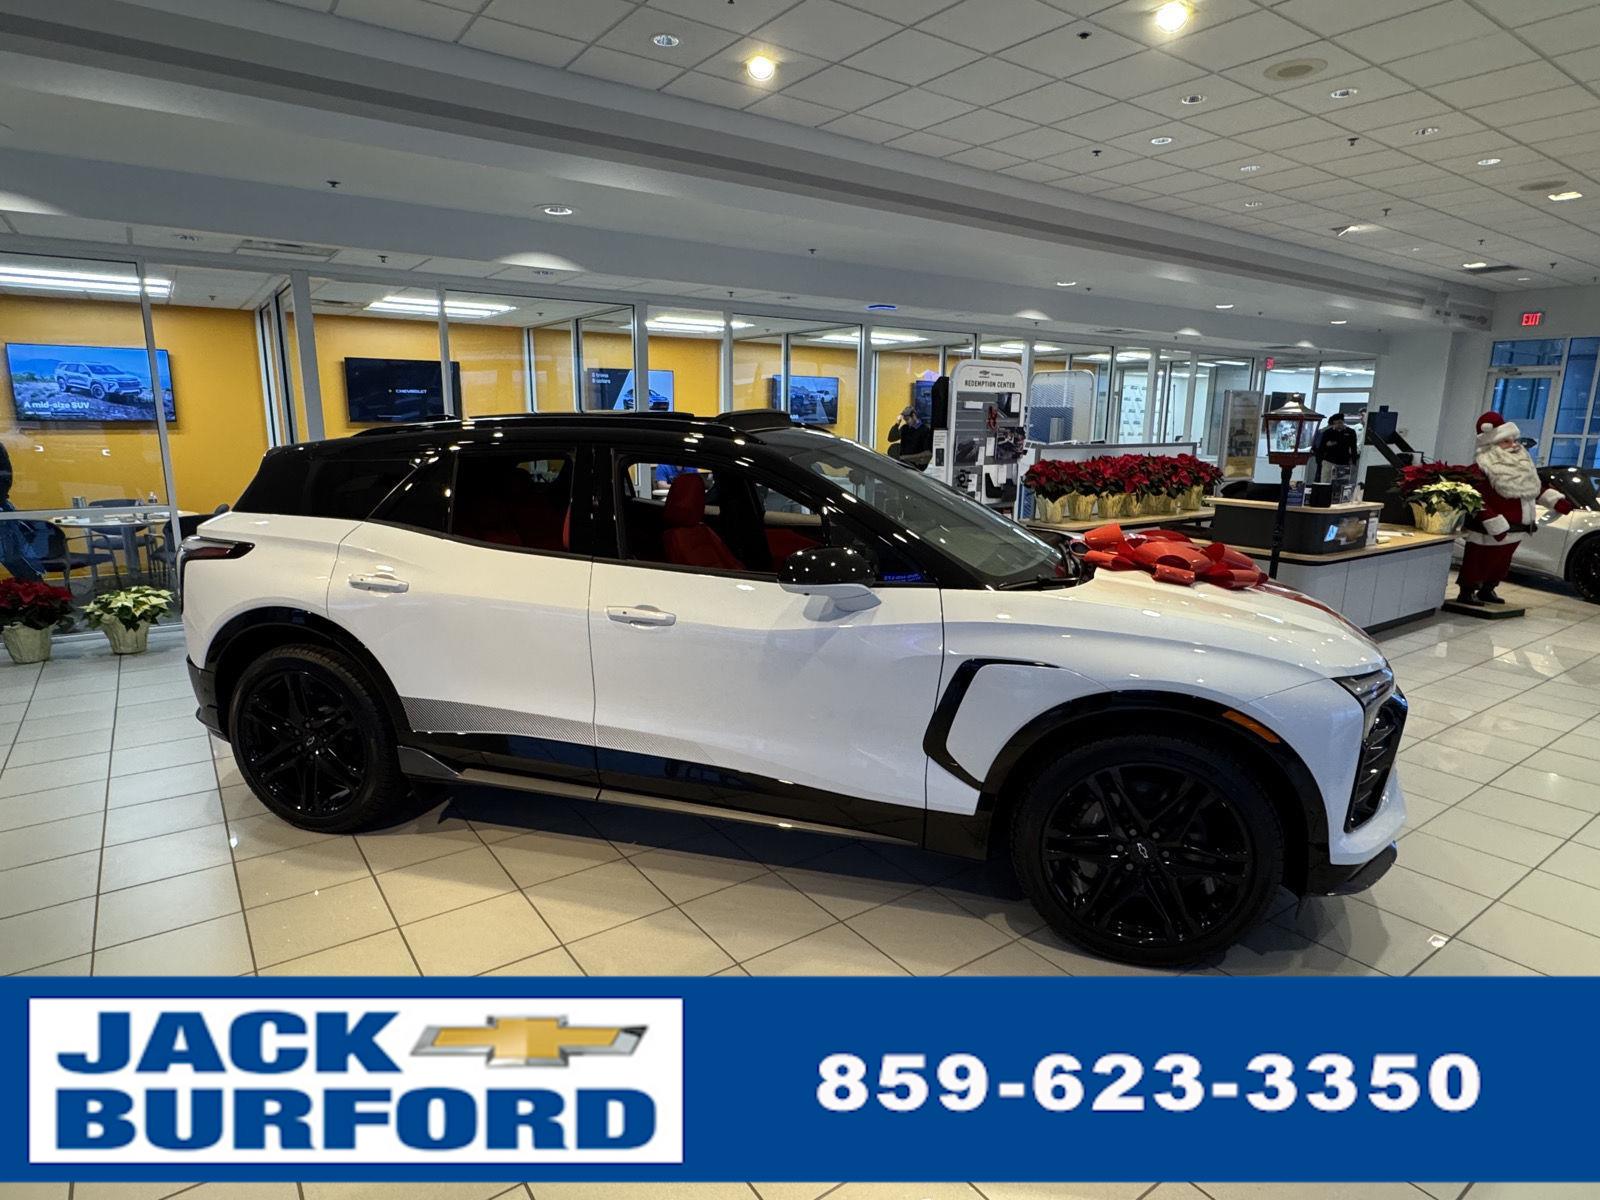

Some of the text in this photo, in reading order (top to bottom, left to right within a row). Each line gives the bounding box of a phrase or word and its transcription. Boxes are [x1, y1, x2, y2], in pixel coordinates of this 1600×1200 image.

[1521, 312, 1542, 326] EXIT
[964, 379, 1016, 389] REDEMPTION CENTER
[71, 401, 90, 409] SUV
